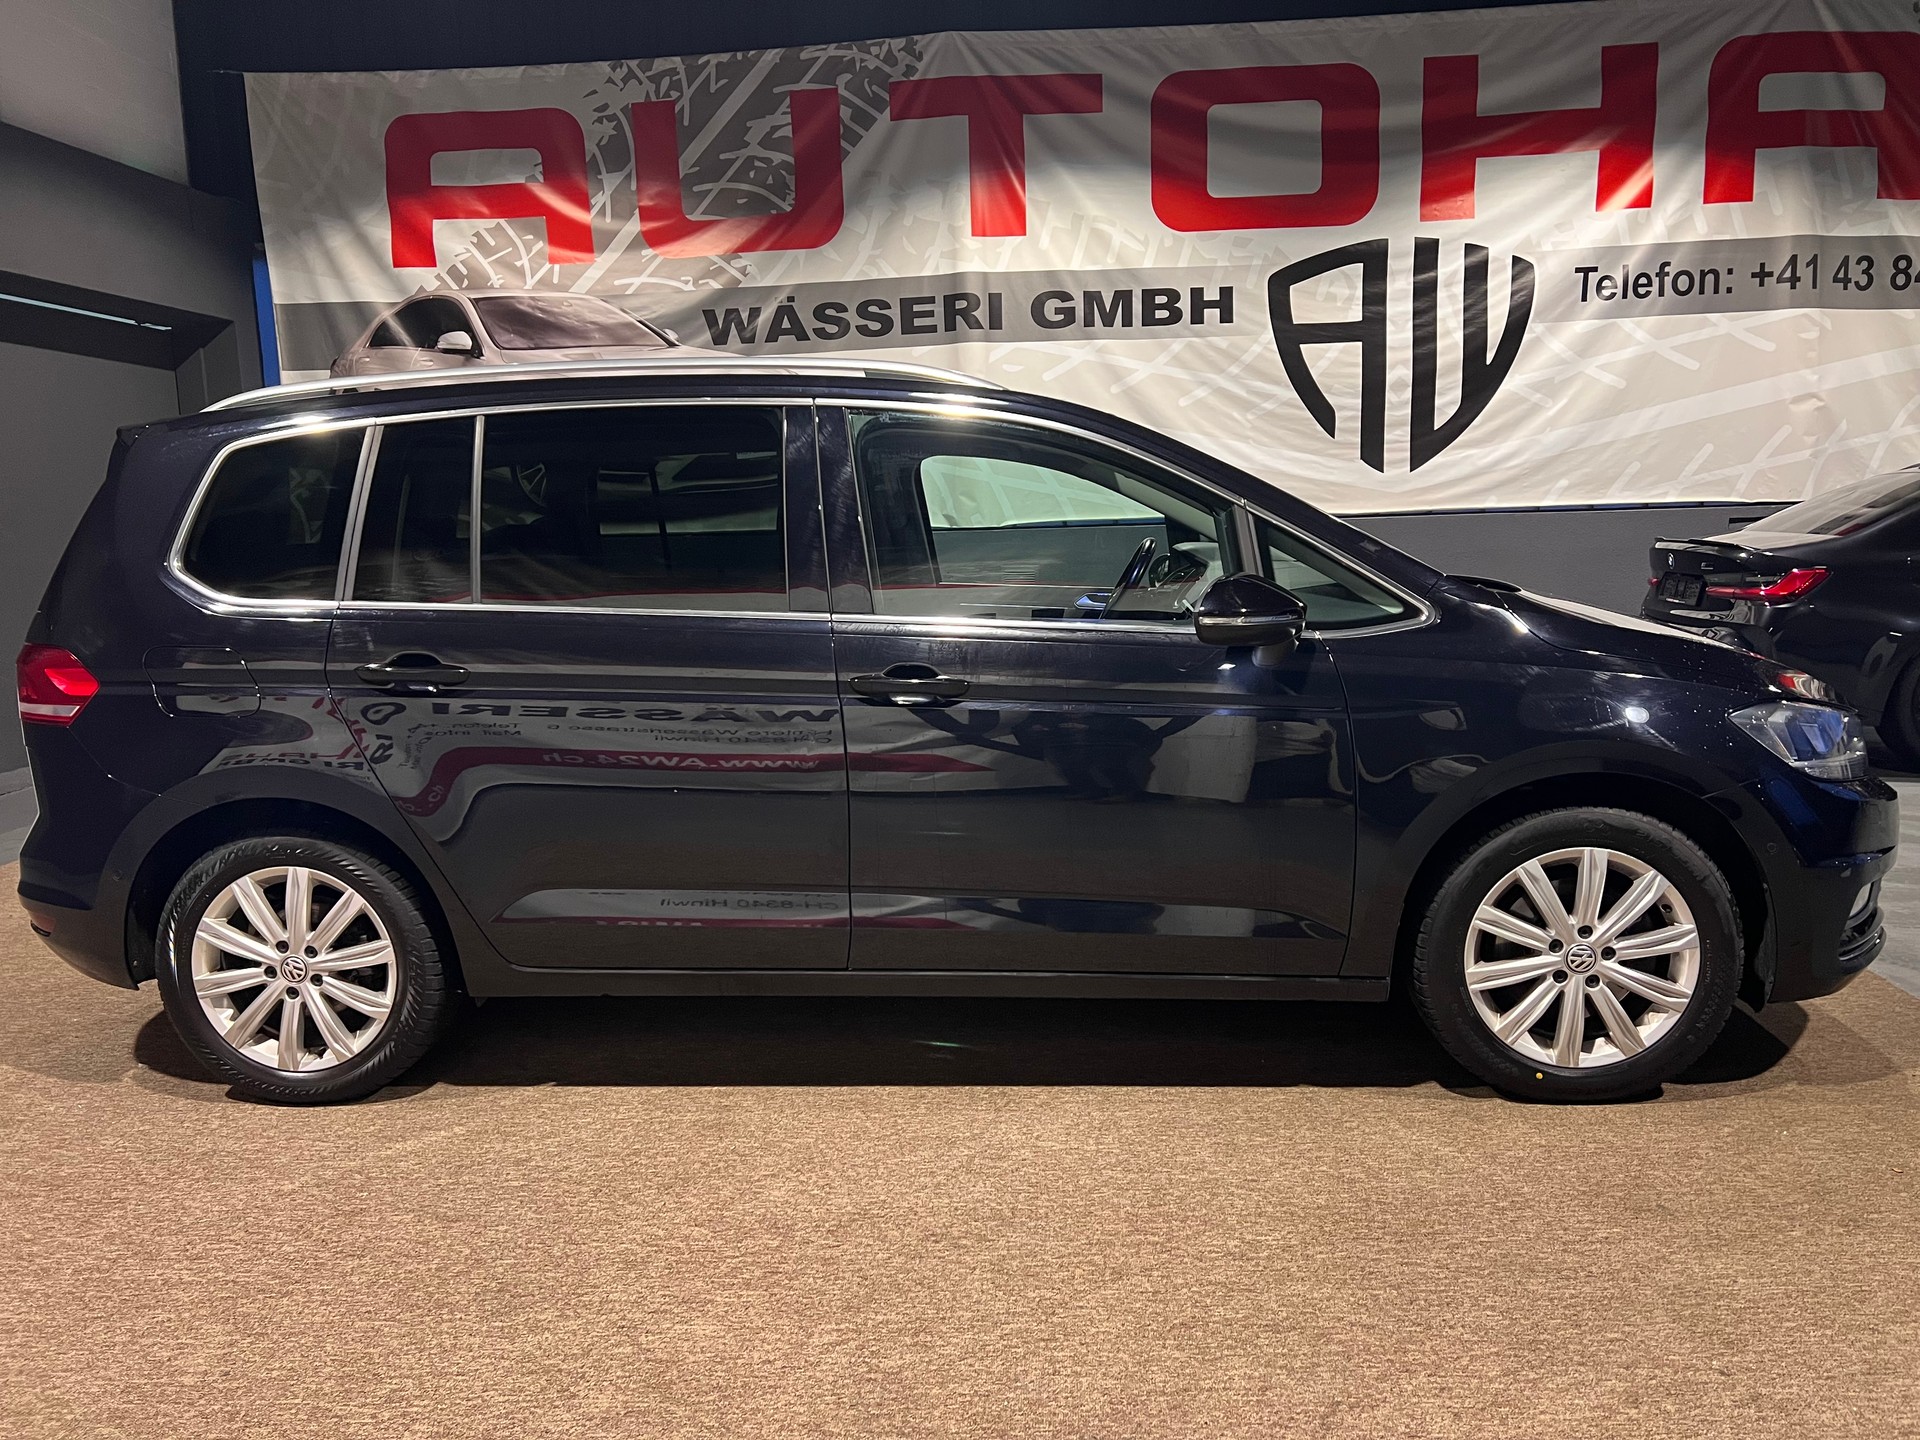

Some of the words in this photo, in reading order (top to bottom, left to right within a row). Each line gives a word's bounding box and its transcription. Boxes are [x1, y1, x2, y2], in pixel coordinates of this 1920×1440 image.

[385, 31, 1920, 267] AUTOHA
[1574, 260, 1735, 303] Telefon:
[1751, 253, 1818, 290] +41
[1832, 254, 1874, 291] 43
[1889, 254, 1920, 291] 8
[702, 292, 1003, 346] WÄSSERI
[1030, 286, 1234, 329] GMBH
